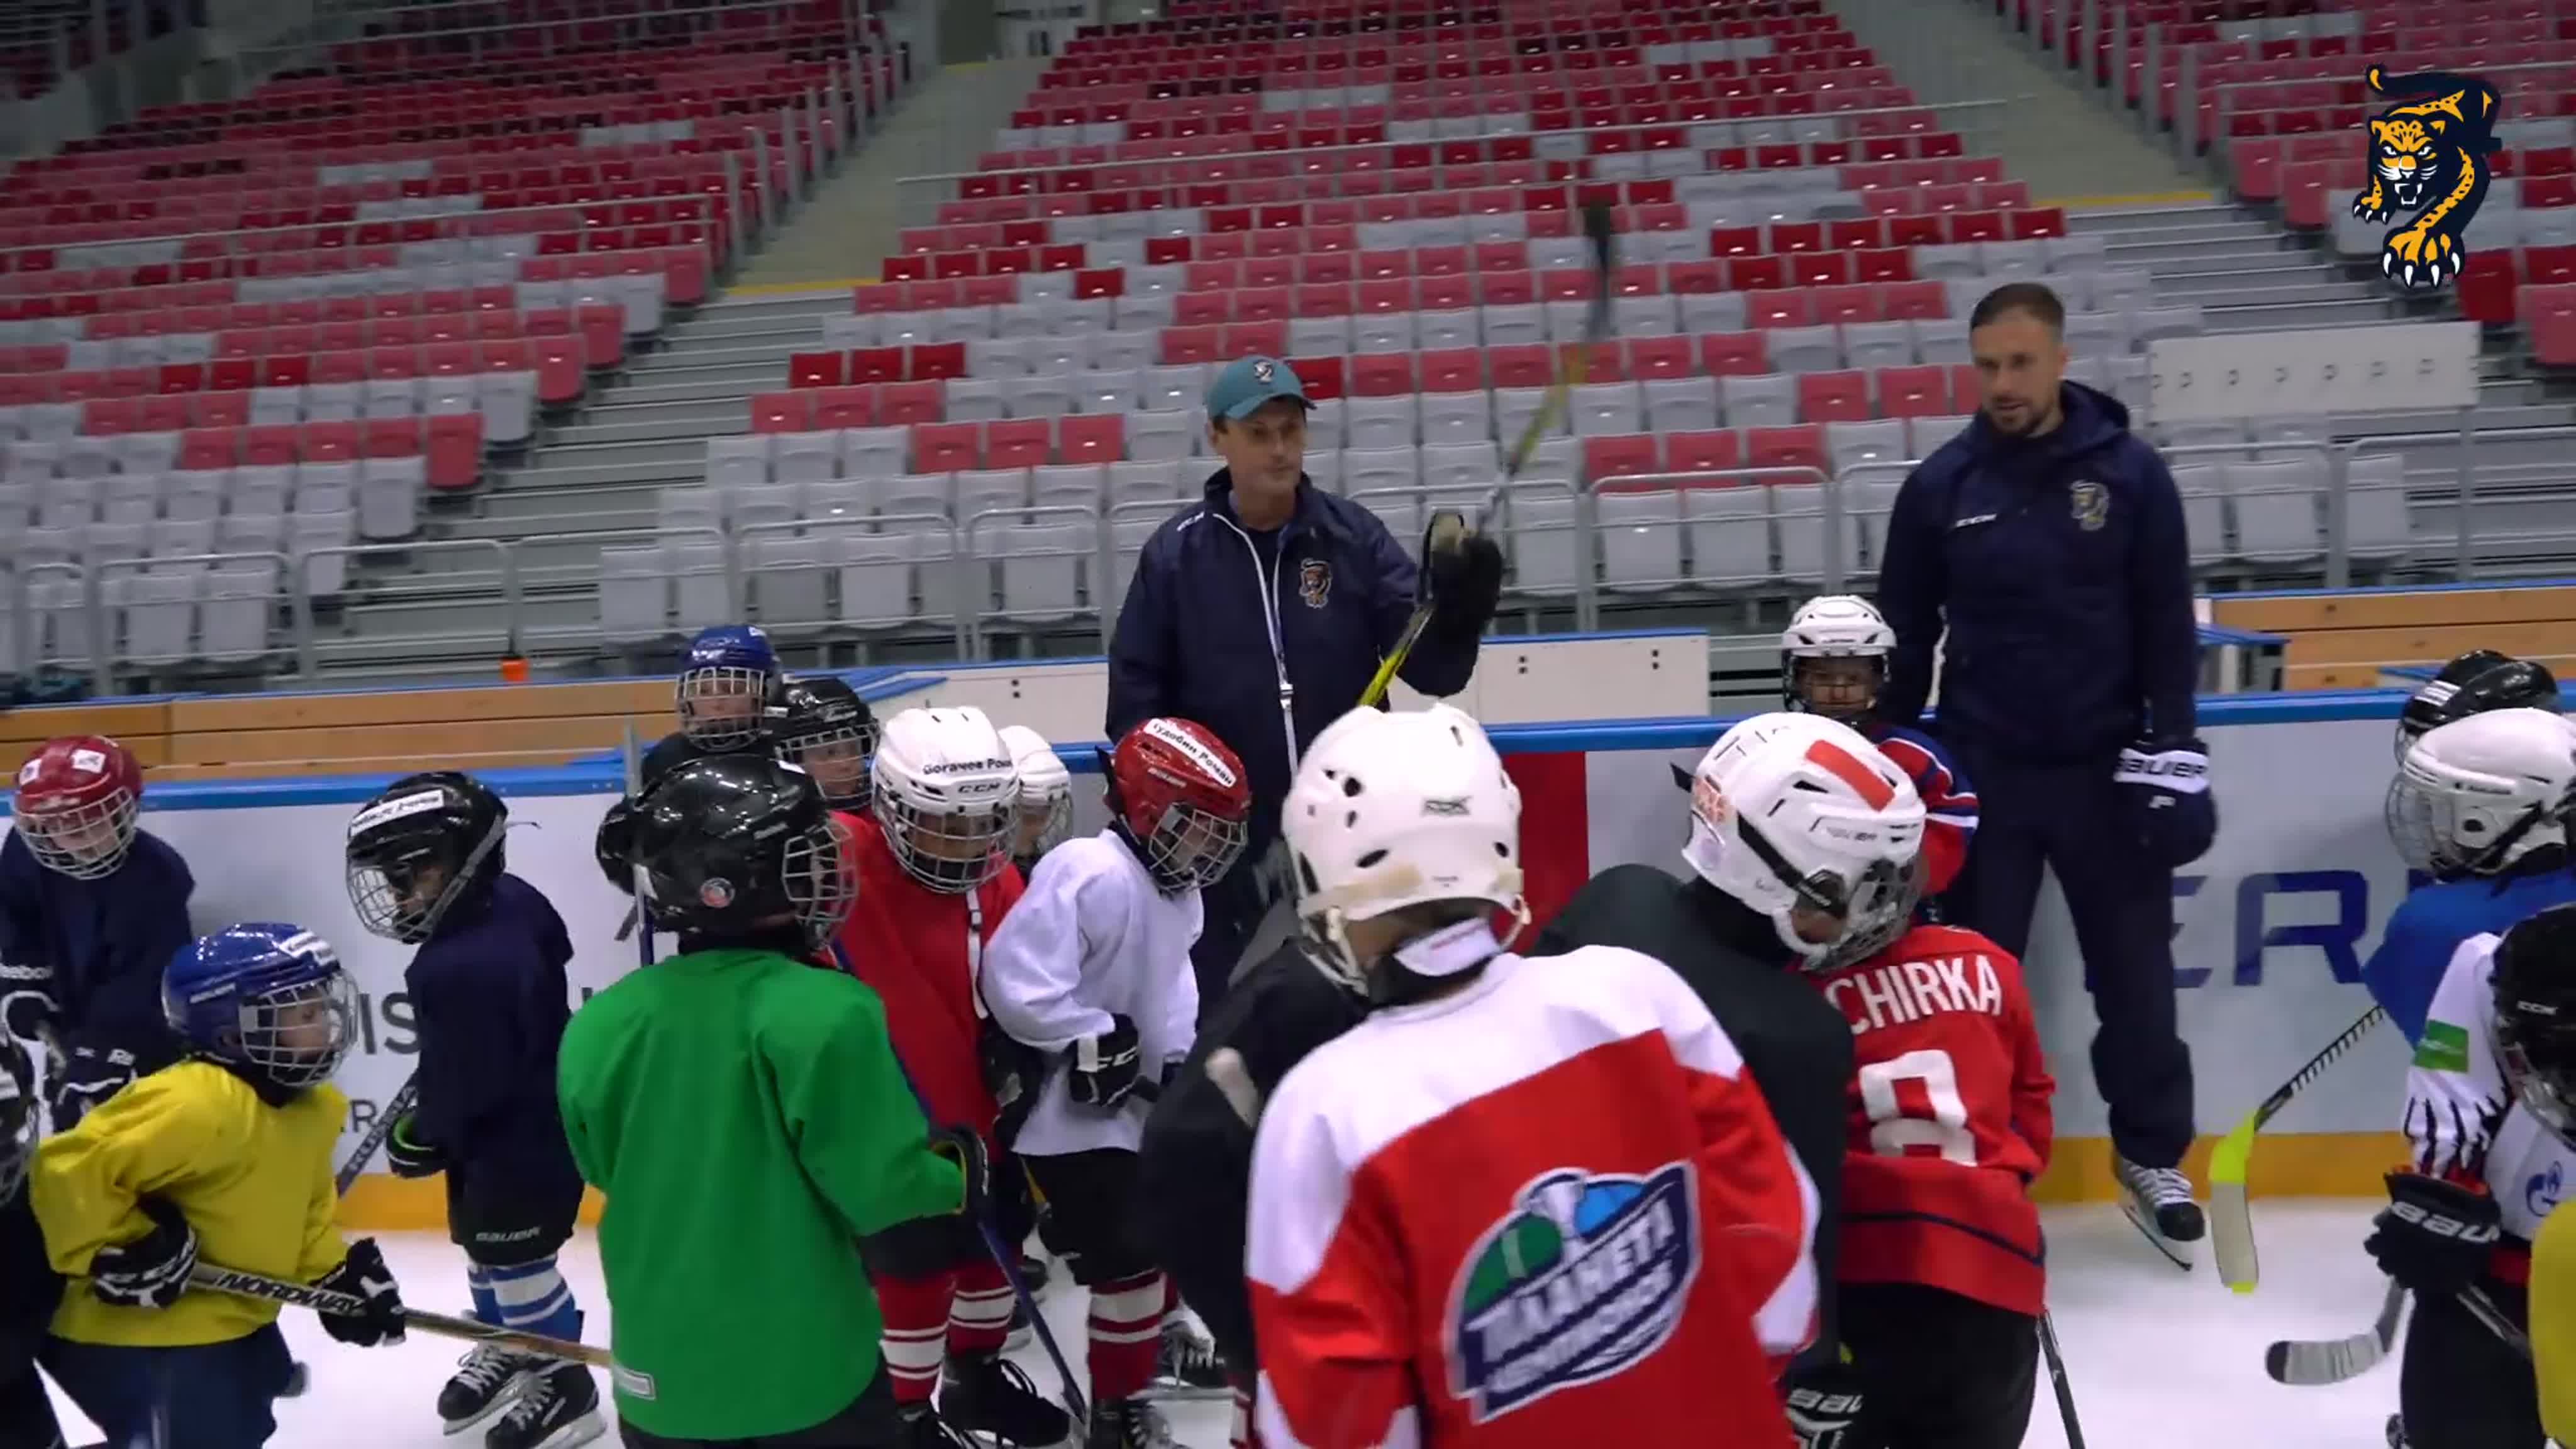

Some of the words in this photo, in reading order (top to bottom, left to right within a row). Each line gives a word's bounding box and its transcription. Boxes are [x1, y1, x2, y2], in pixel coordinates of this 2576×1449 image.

[958, 782, 1001, 793] CCM
[1824, 955, 2002, 1035] CHIRKA
[1858, 1049, 1978, 1167] 8
